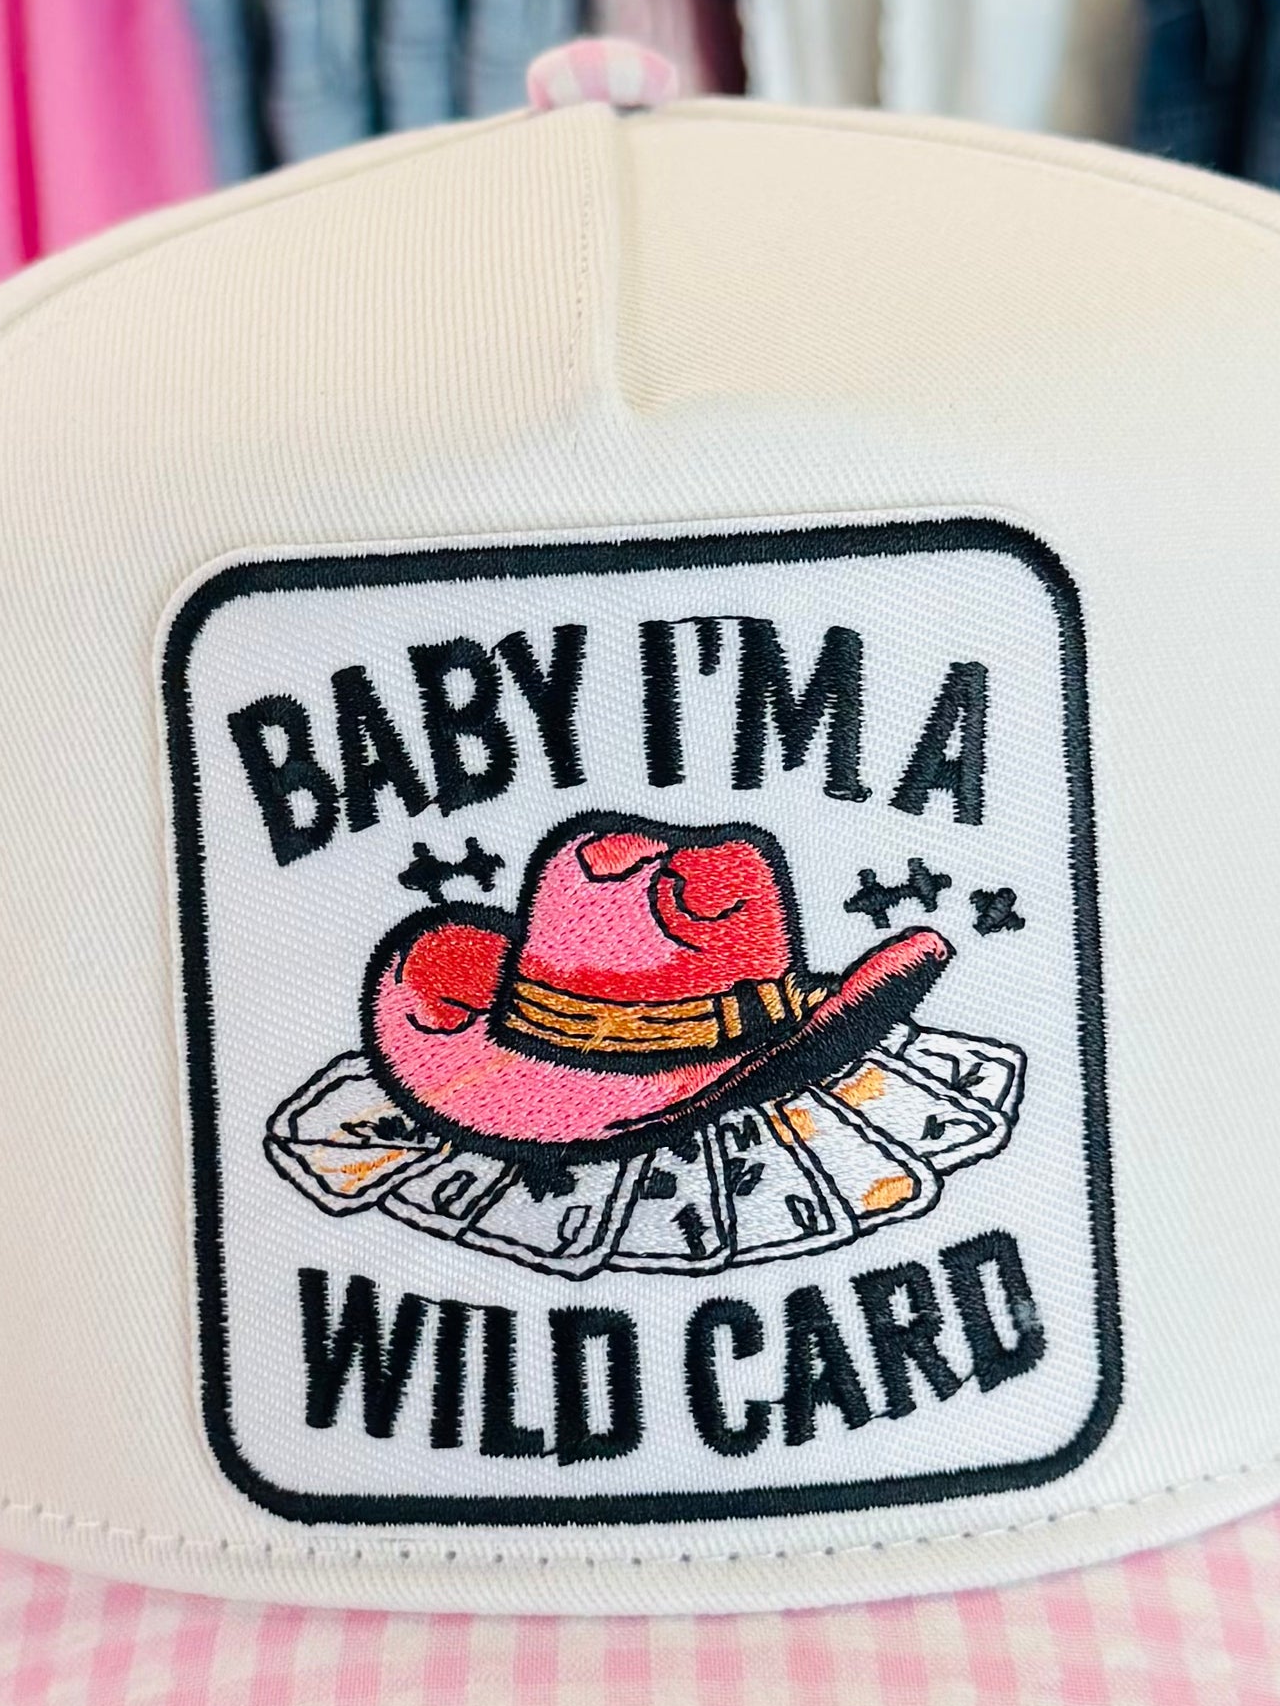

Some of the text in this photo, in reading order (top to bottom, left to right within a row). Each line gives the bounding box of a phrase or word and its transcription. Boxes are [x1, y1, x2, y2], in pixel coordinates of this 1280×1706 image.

[227, 616, 990, 867] BABY I'M A
[298, 1229, 1047, 1467] WILD CARD
